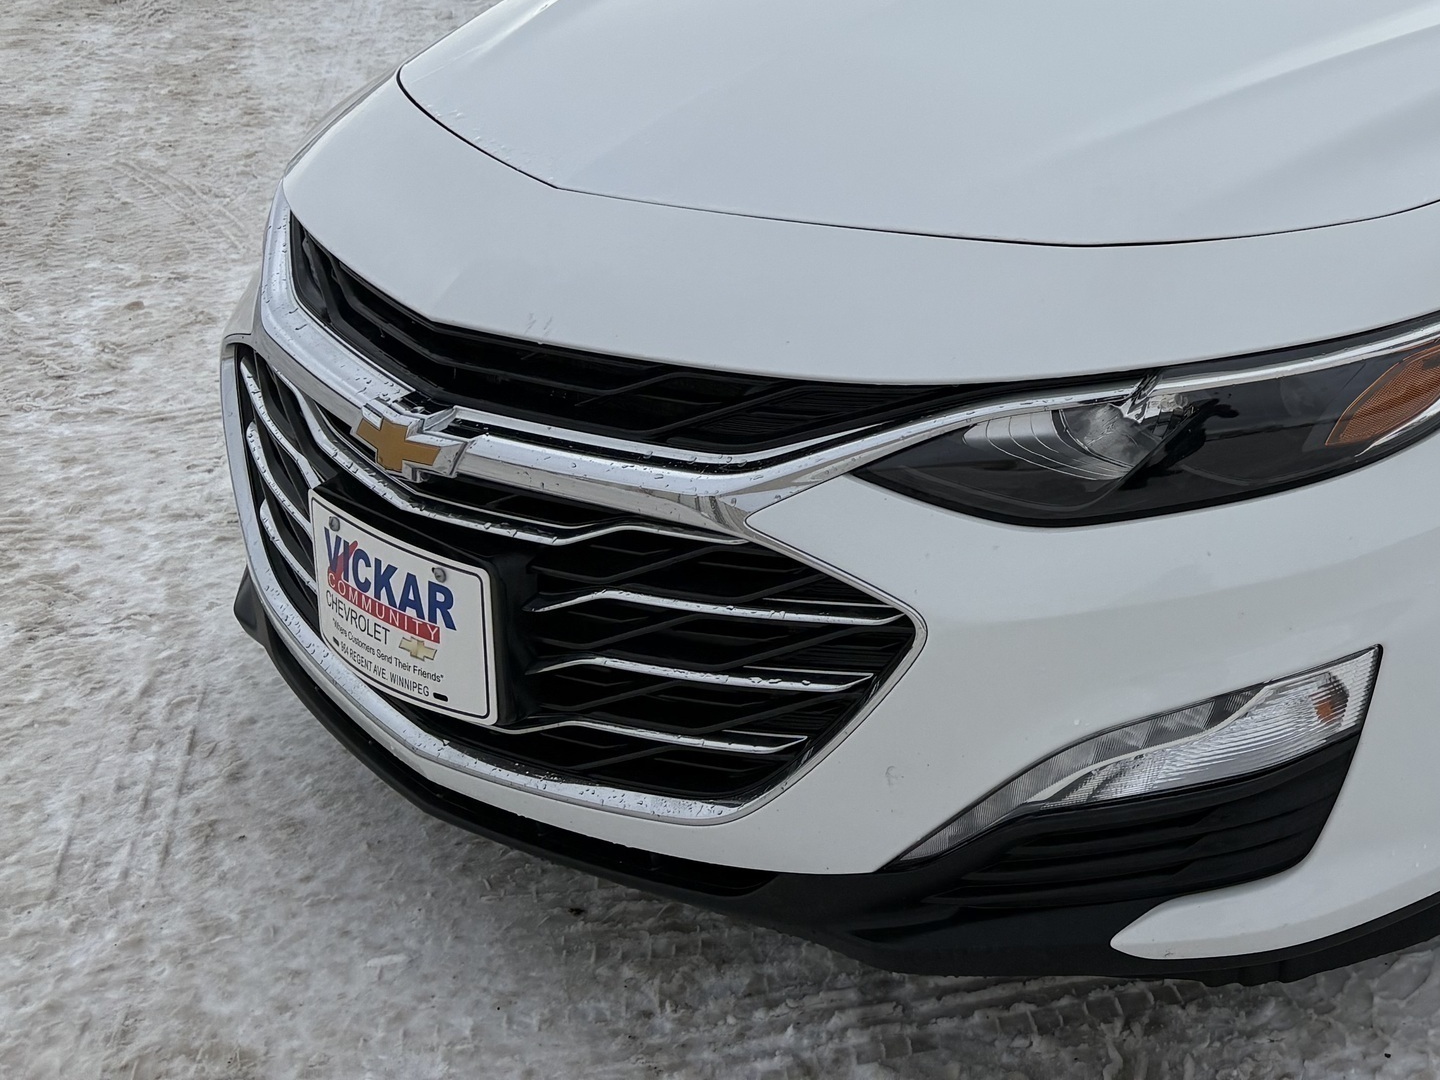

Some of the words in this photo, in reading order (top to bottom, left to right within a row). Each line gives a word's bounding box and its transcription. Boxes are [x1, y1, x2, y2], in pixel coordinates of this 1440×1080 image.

[324, 526, 457, 631] VICKAR
[328, 572, 440, 641] COMMUNITY
[326, 589, 390, 645] CHEVROLET
[347, 631, 376, 656] Customers
[376, 648, 393, 665] Send
[393, 656, 412, 672] Their
[349, 648, 373, 672] REGENT
[389, 671, 430, 697] WINNIPEG
